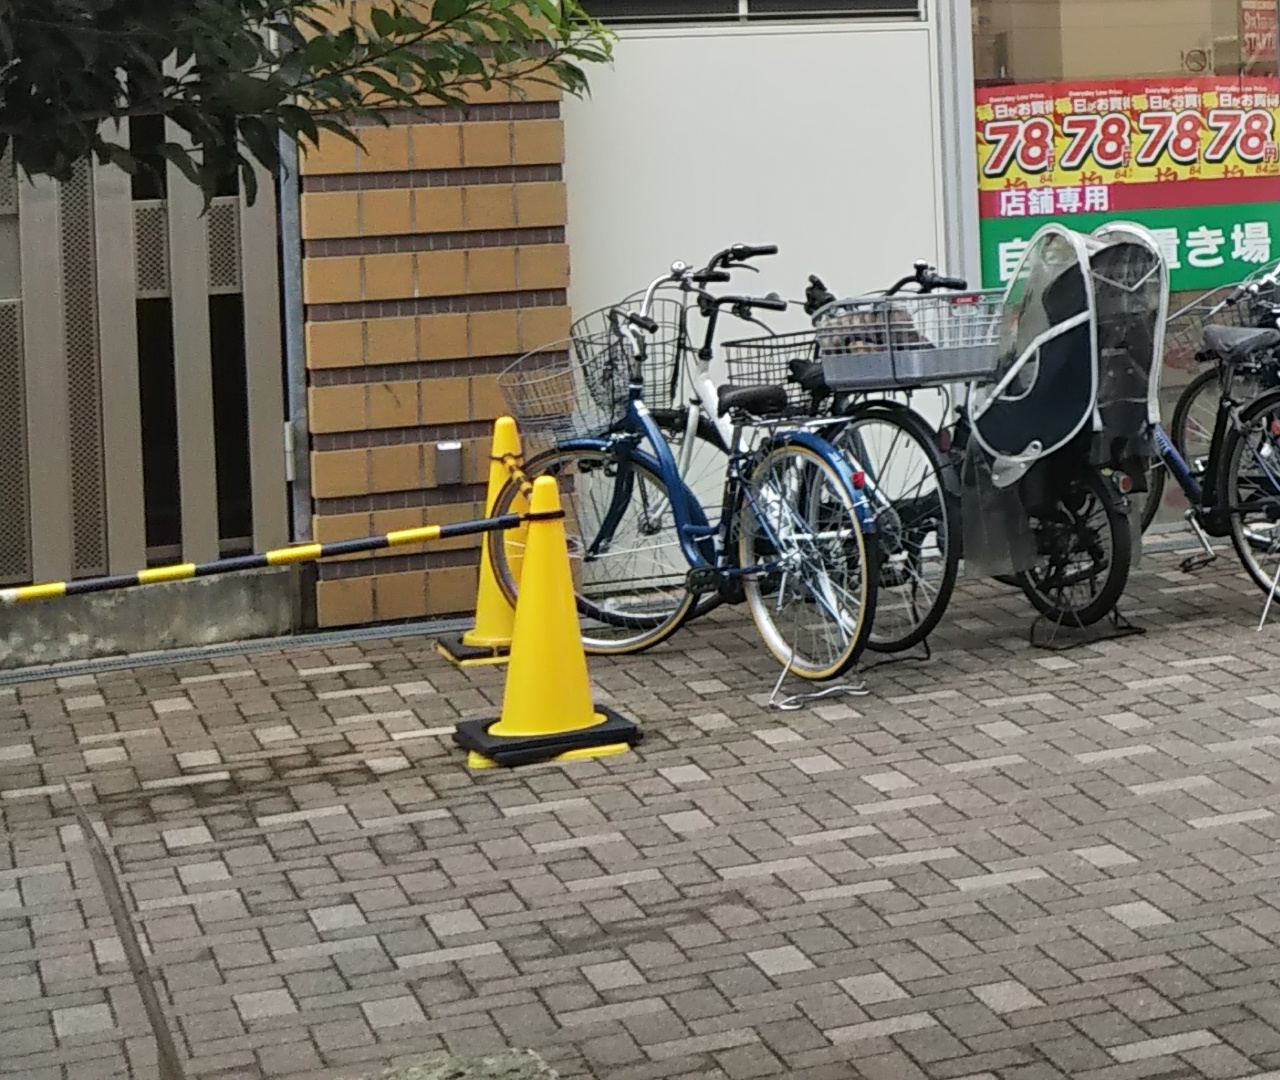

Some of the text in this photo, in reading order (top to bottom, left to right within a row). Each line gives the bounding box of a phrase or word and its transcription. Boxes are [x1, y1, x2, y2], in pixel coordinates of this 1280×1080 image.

[999, 184, 1110, 217] 店舗専用
[998, 222, 1271, 281] 自置き場
